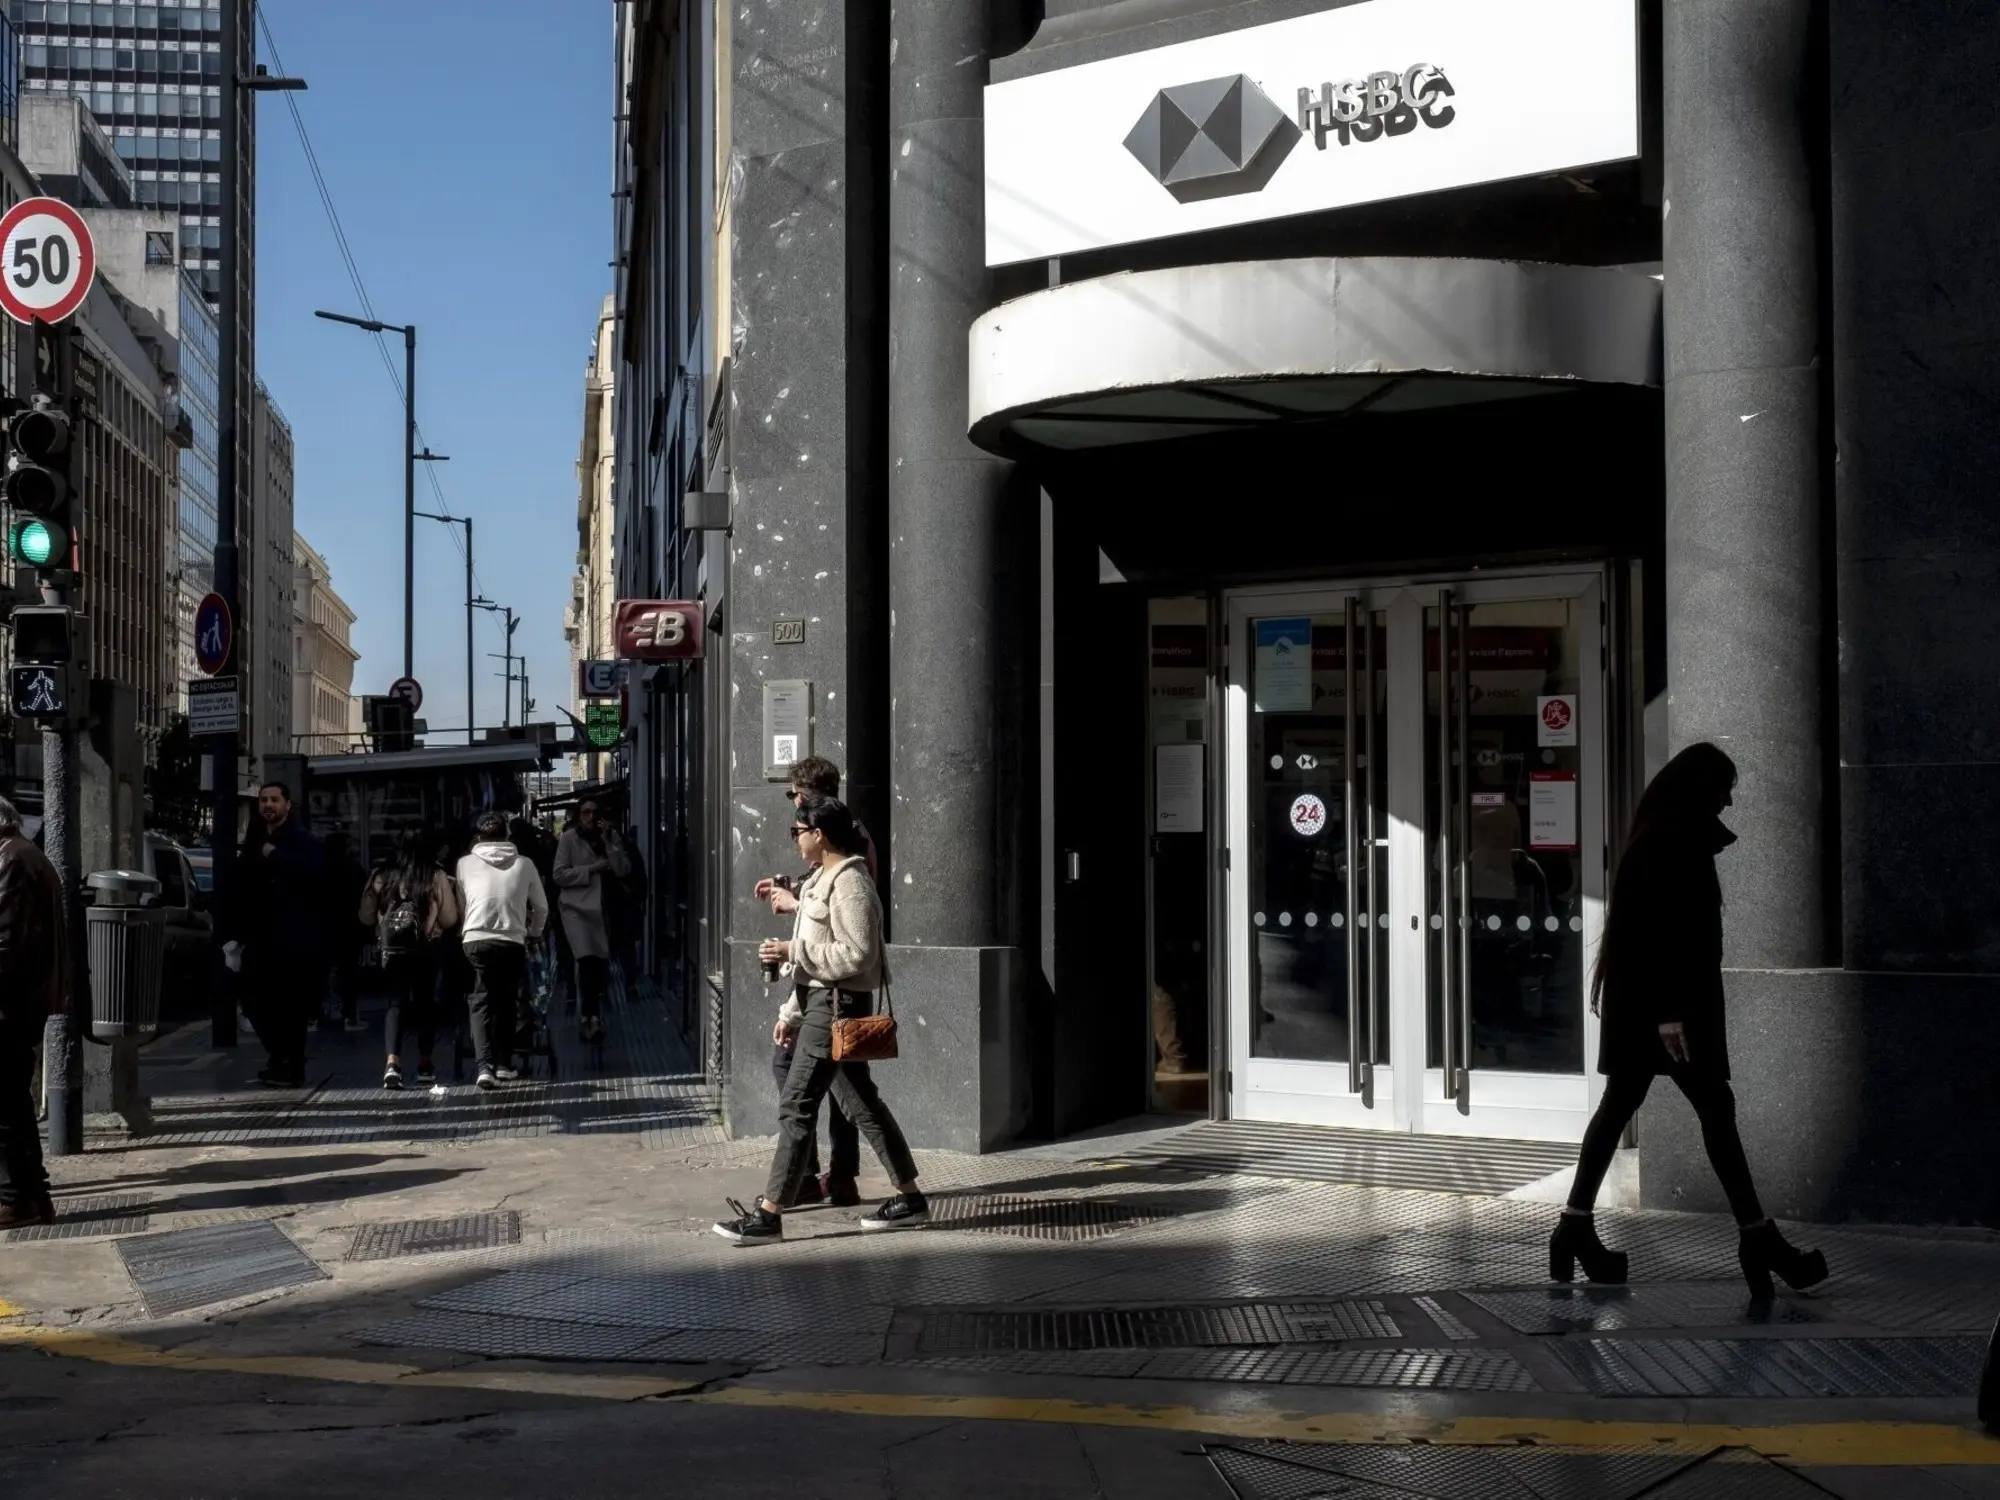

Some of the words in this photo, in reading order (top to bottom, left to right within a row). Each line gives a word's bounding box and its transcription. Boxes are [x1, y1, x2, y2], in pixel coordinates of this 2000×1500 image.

[1297, 62, 1442, 132] HSBC
[12, 235, 70, 288] 50
[654, 612, 685, 646] B
[775, 623, 801, 640] 500
[1295, 804, 1320, 823] 24
